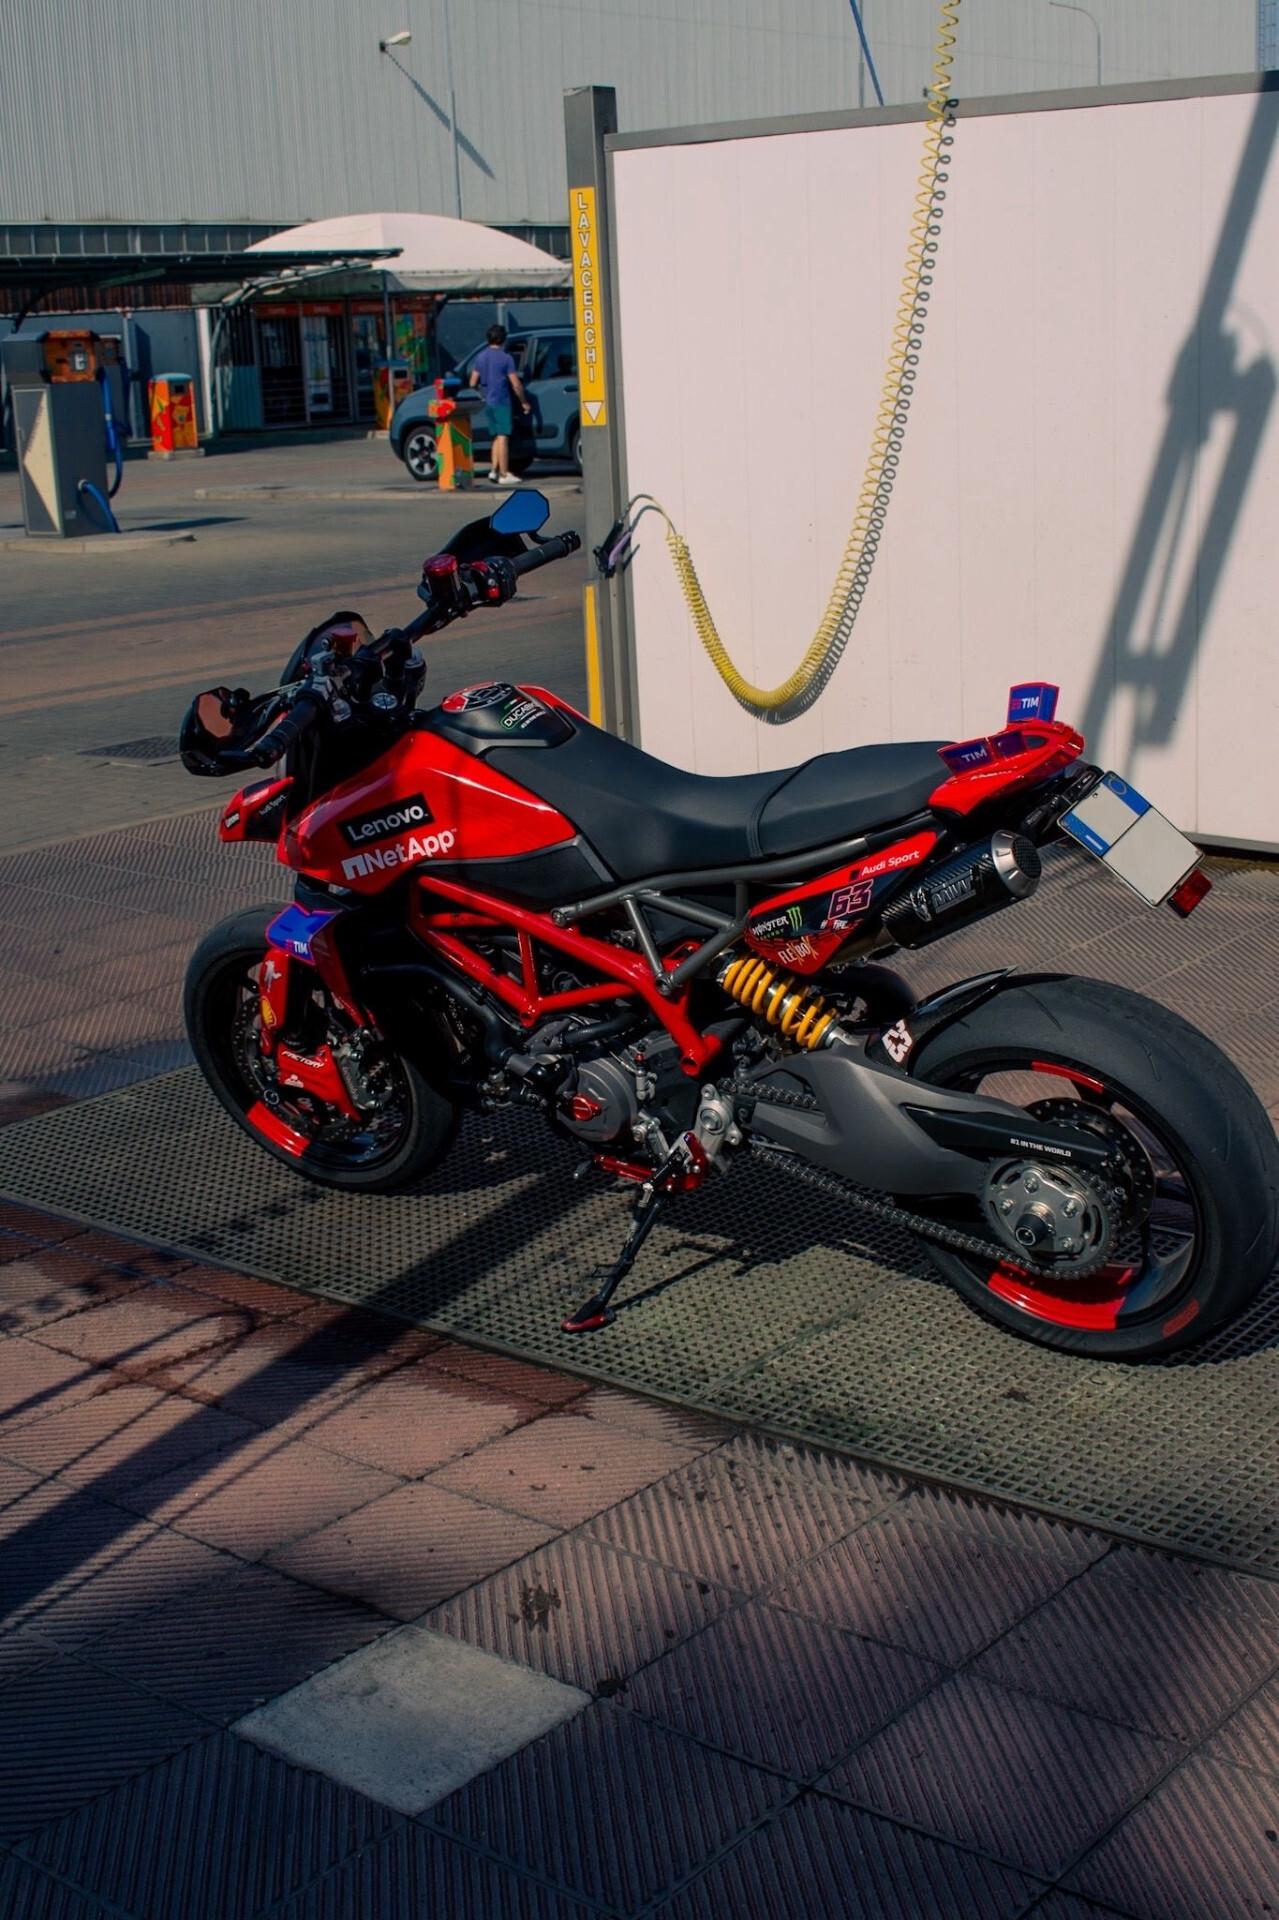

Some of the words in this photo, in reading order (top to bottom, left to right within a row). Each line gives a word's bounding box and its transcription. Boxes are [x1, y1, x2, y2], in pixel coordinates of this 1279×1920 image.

[577, 192, 597, 384] LAVACERCHI
[1021, 697, 1039, 709] TIM
[961, 746, 987, 762] TIM
[347, 806, 424, 841] Lenovo
[363, 830, 455, 873] NetApp
[861, 863, 886, 876] Audi
[889, 851, 919, 866] Sport
[827, 879, 874, 920] 63
[293, 941, 308, 955] TIM
[281, 1050, 325, 1069] FACTORY
[1043, 1145, 1072, 1157] WORLD
